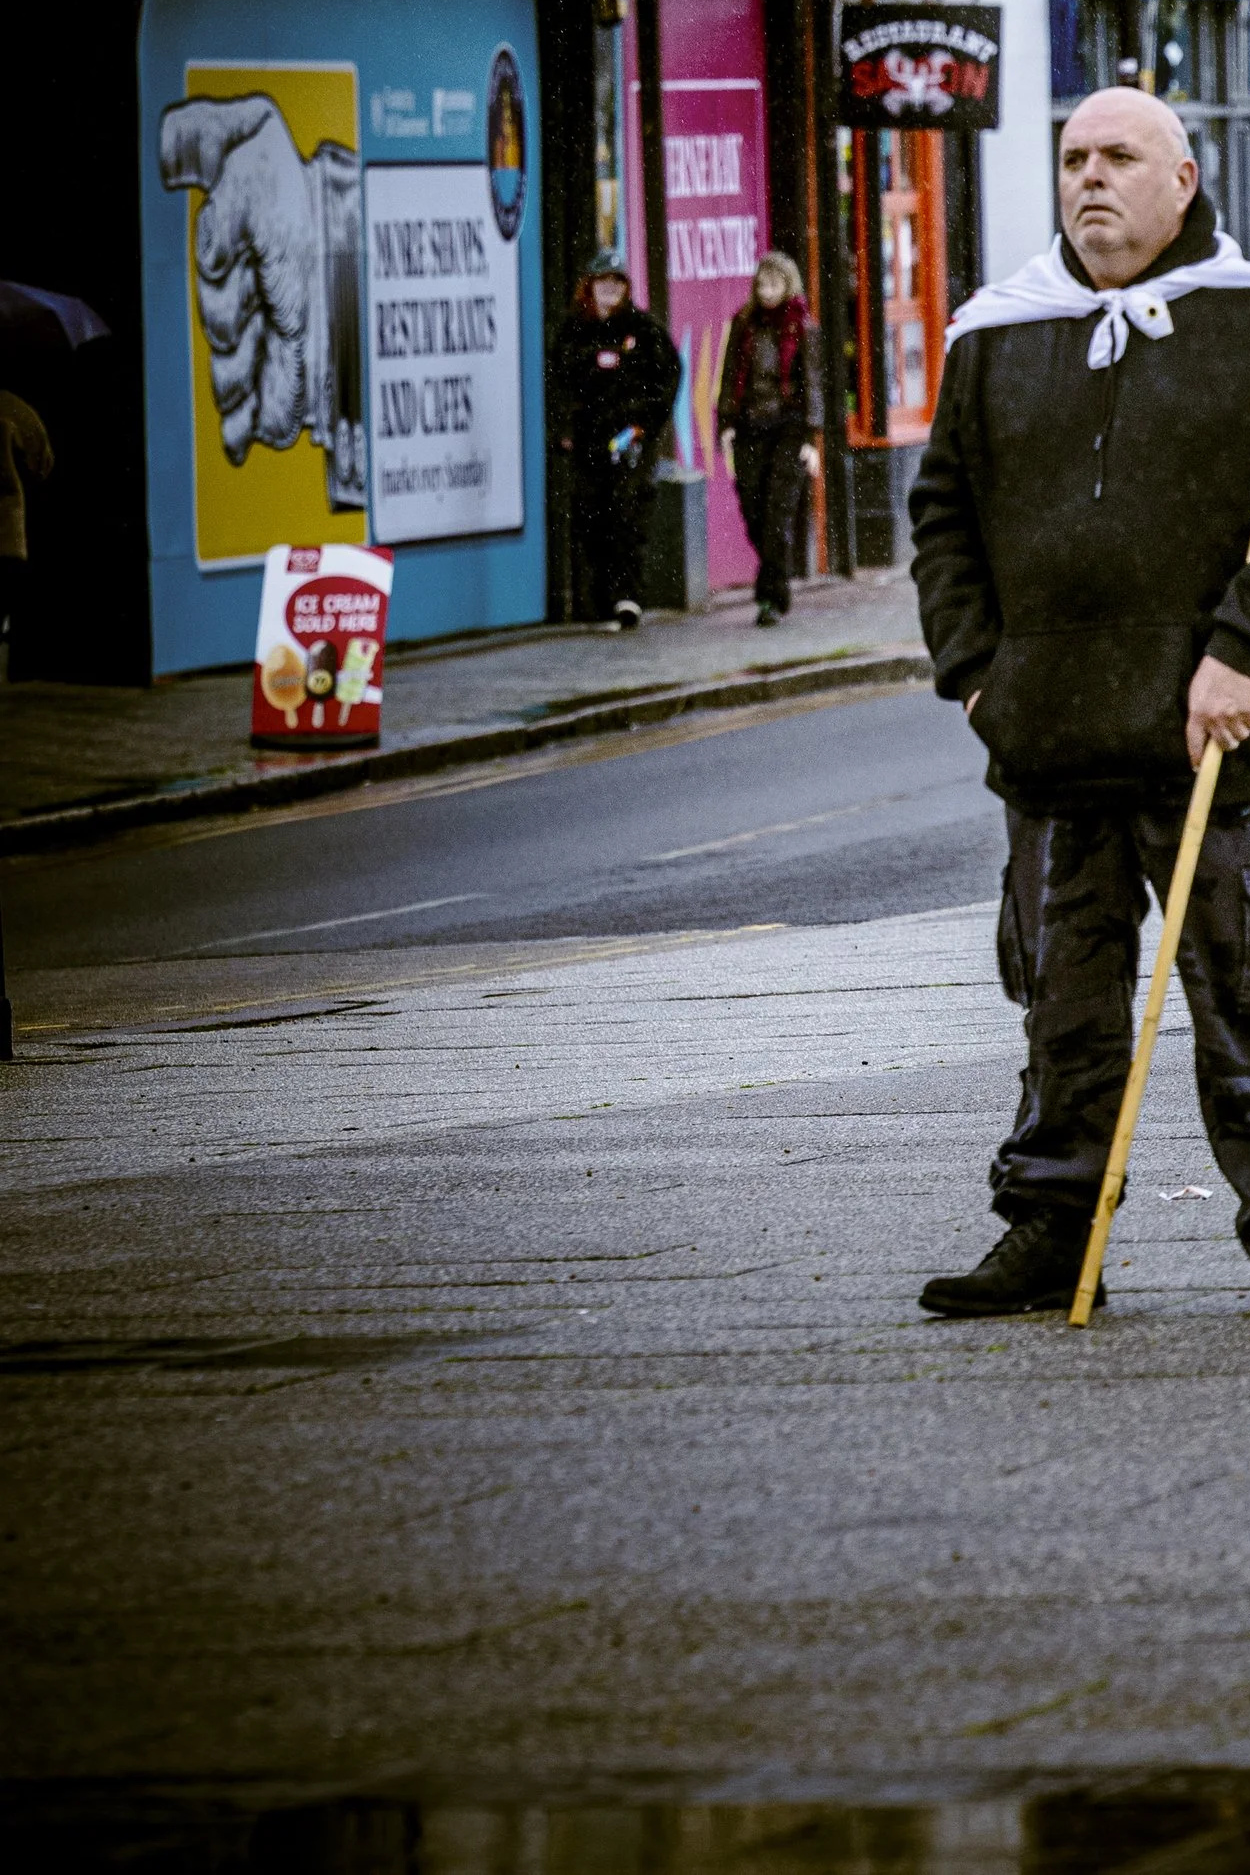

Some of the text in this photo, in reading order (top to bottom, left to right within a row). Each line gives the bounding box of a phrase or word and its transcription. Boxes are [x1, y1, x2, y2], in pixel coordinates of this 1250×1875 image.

[843, 19, 998, 63] RESTAURANT
[374, 221, 424, 278] MORE
[697, 214, 758, 279] CENTRE
[376, 295, 497, 359] RESTAURANTS
[377, 379, 418, 439] AND
[292, 612, 378, 633] SOLD HERE
[294, 592, 380, 614] ICE CREAM
